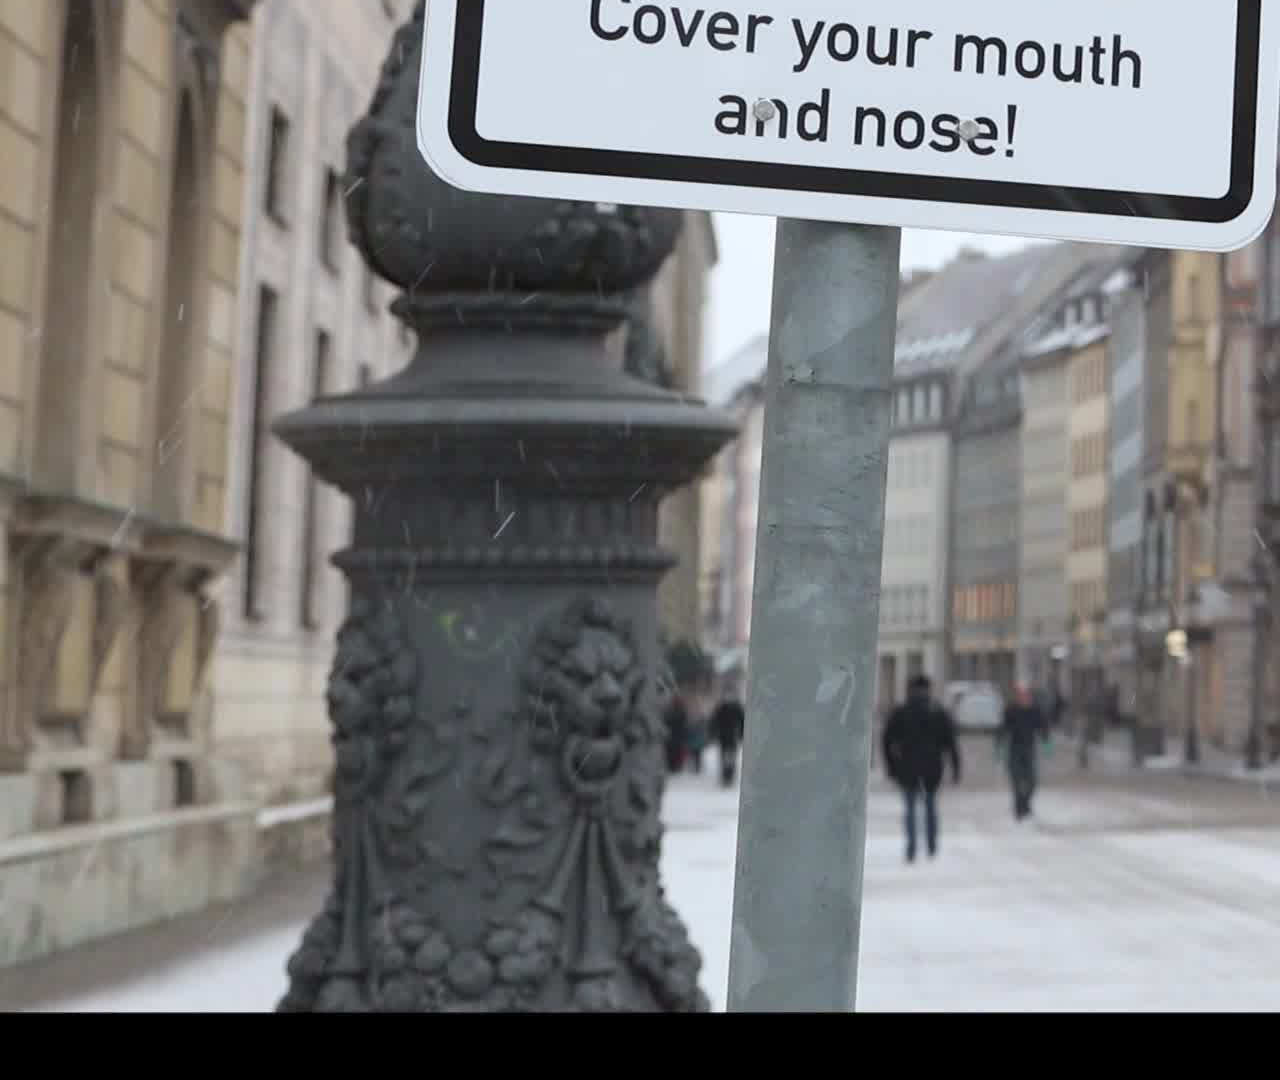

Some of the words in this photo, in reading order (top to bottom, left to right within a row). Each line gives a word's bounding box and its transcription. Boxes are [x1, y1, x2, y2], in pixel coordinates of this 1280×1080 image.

[790, 17, 933, 74] your
[953, 31, 1142, 89] mouth
[713, 87, 831, 142] and
[853, 104, 1018, 158] nose!
